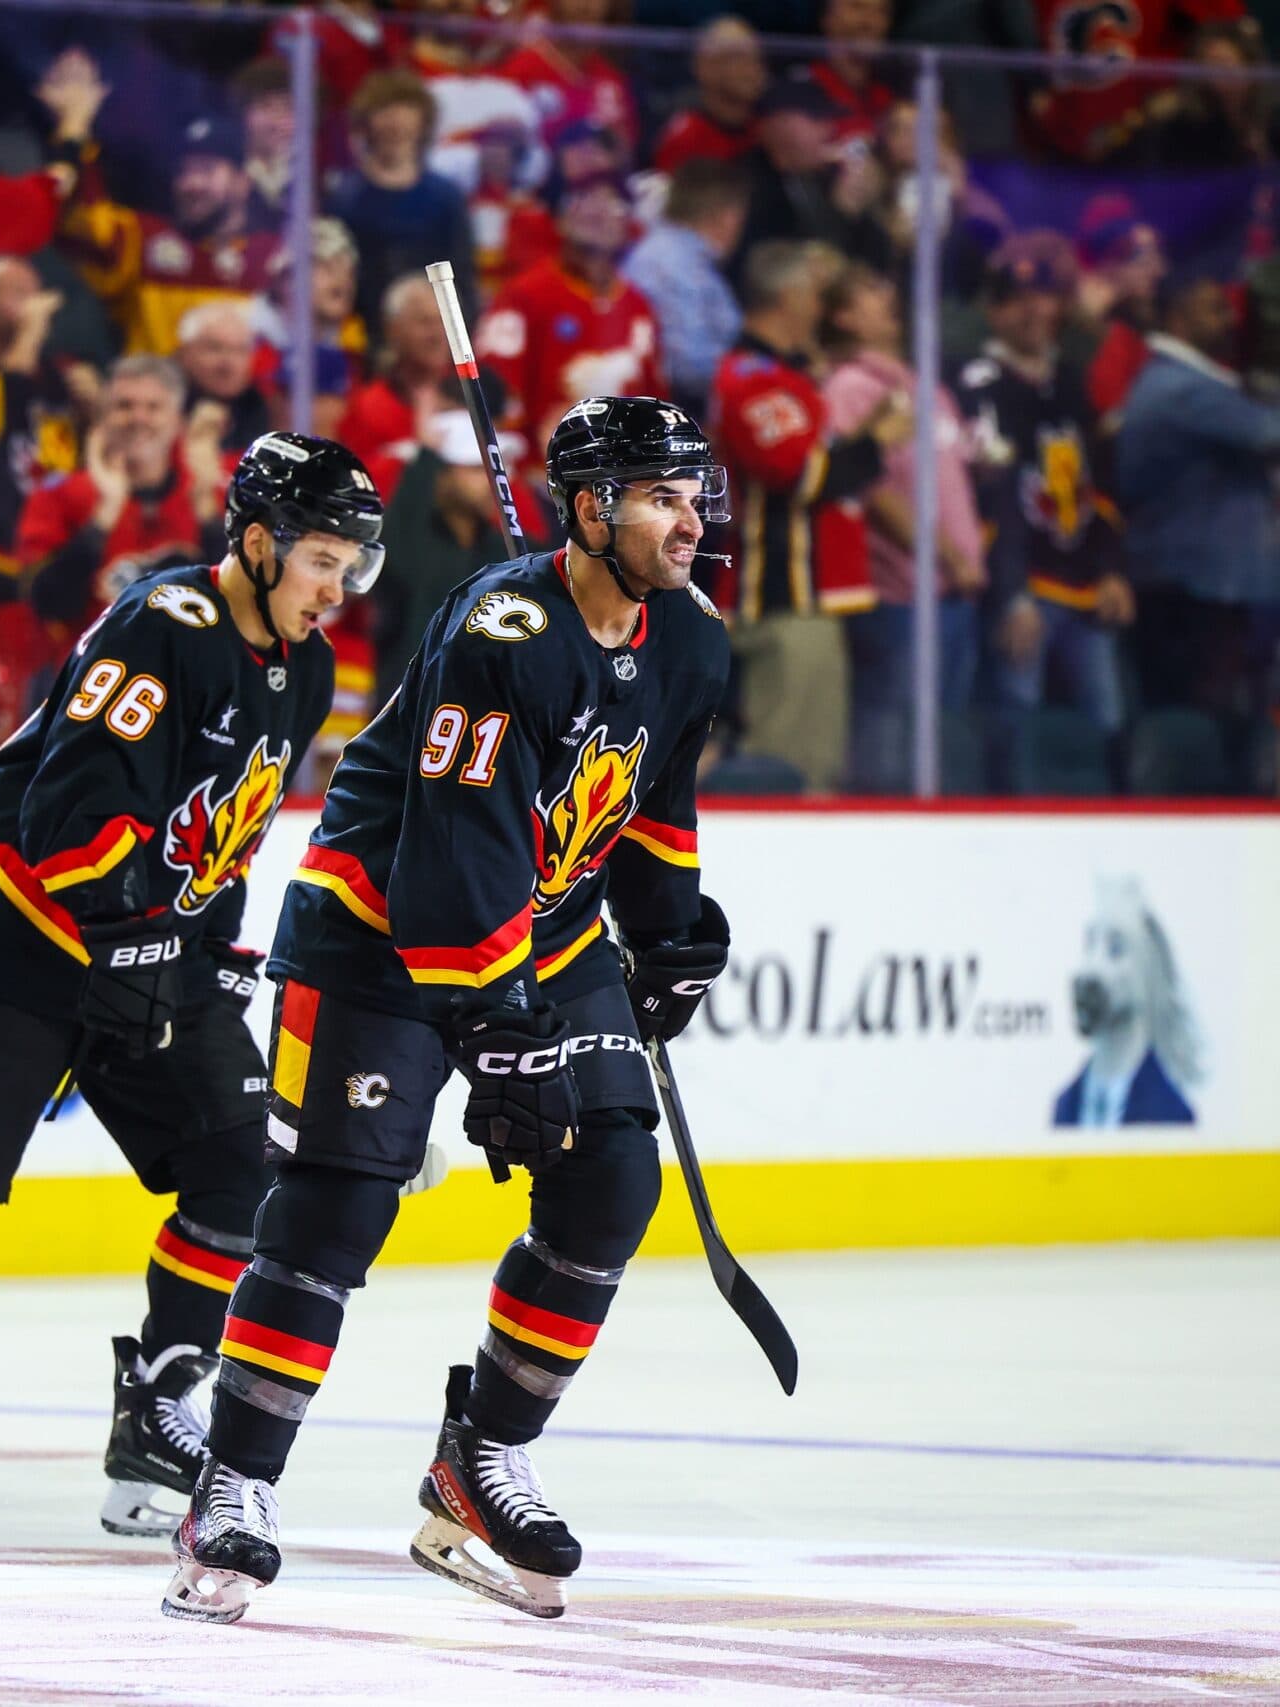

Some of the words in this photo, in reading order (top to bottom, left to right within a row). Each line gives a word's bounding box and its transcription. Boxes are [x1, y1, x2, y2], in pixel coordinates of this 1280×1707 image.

[670, 441, 707, 453] CCM
[487, 443, 524, 538] CCM
[66, 658, 168, 741] 96
[420, 704, 510, 787] 91
[110, 935, 182, 968] BAU
[643, 994, 661, 1013] 91
[435, 1468, 469, 1520] CCM
